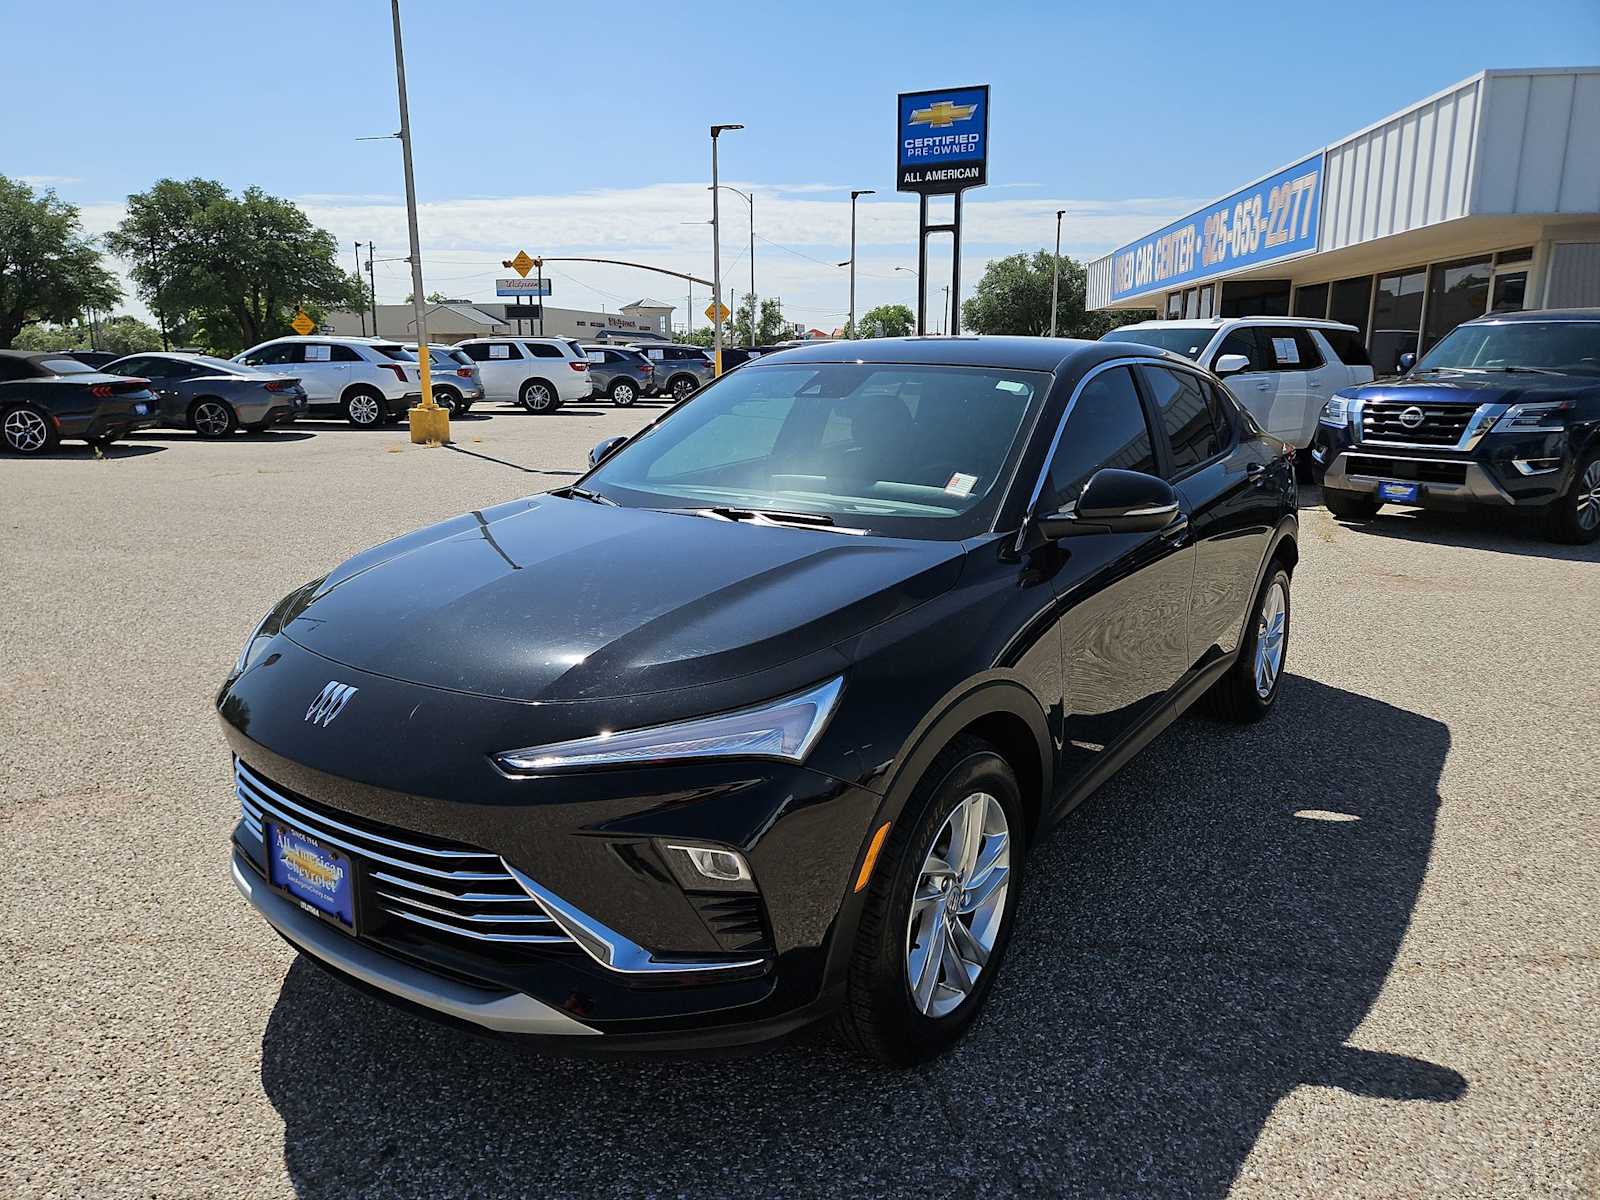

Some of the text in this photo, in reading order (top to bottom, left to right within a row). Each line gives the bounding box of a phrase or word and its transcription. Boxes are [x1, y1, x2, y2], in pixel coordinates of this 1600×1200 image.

[904, 133, 979, 149] CERTIFIED
[907, 143, 975, 157] PRE-OWNED
[904, 167, 979, 183] ALL AMERICAN
[1135, 242, 1154, 288] CAR
[1154, 223, 1195, 282] CENTER
[276, 834, 290, 848] All
